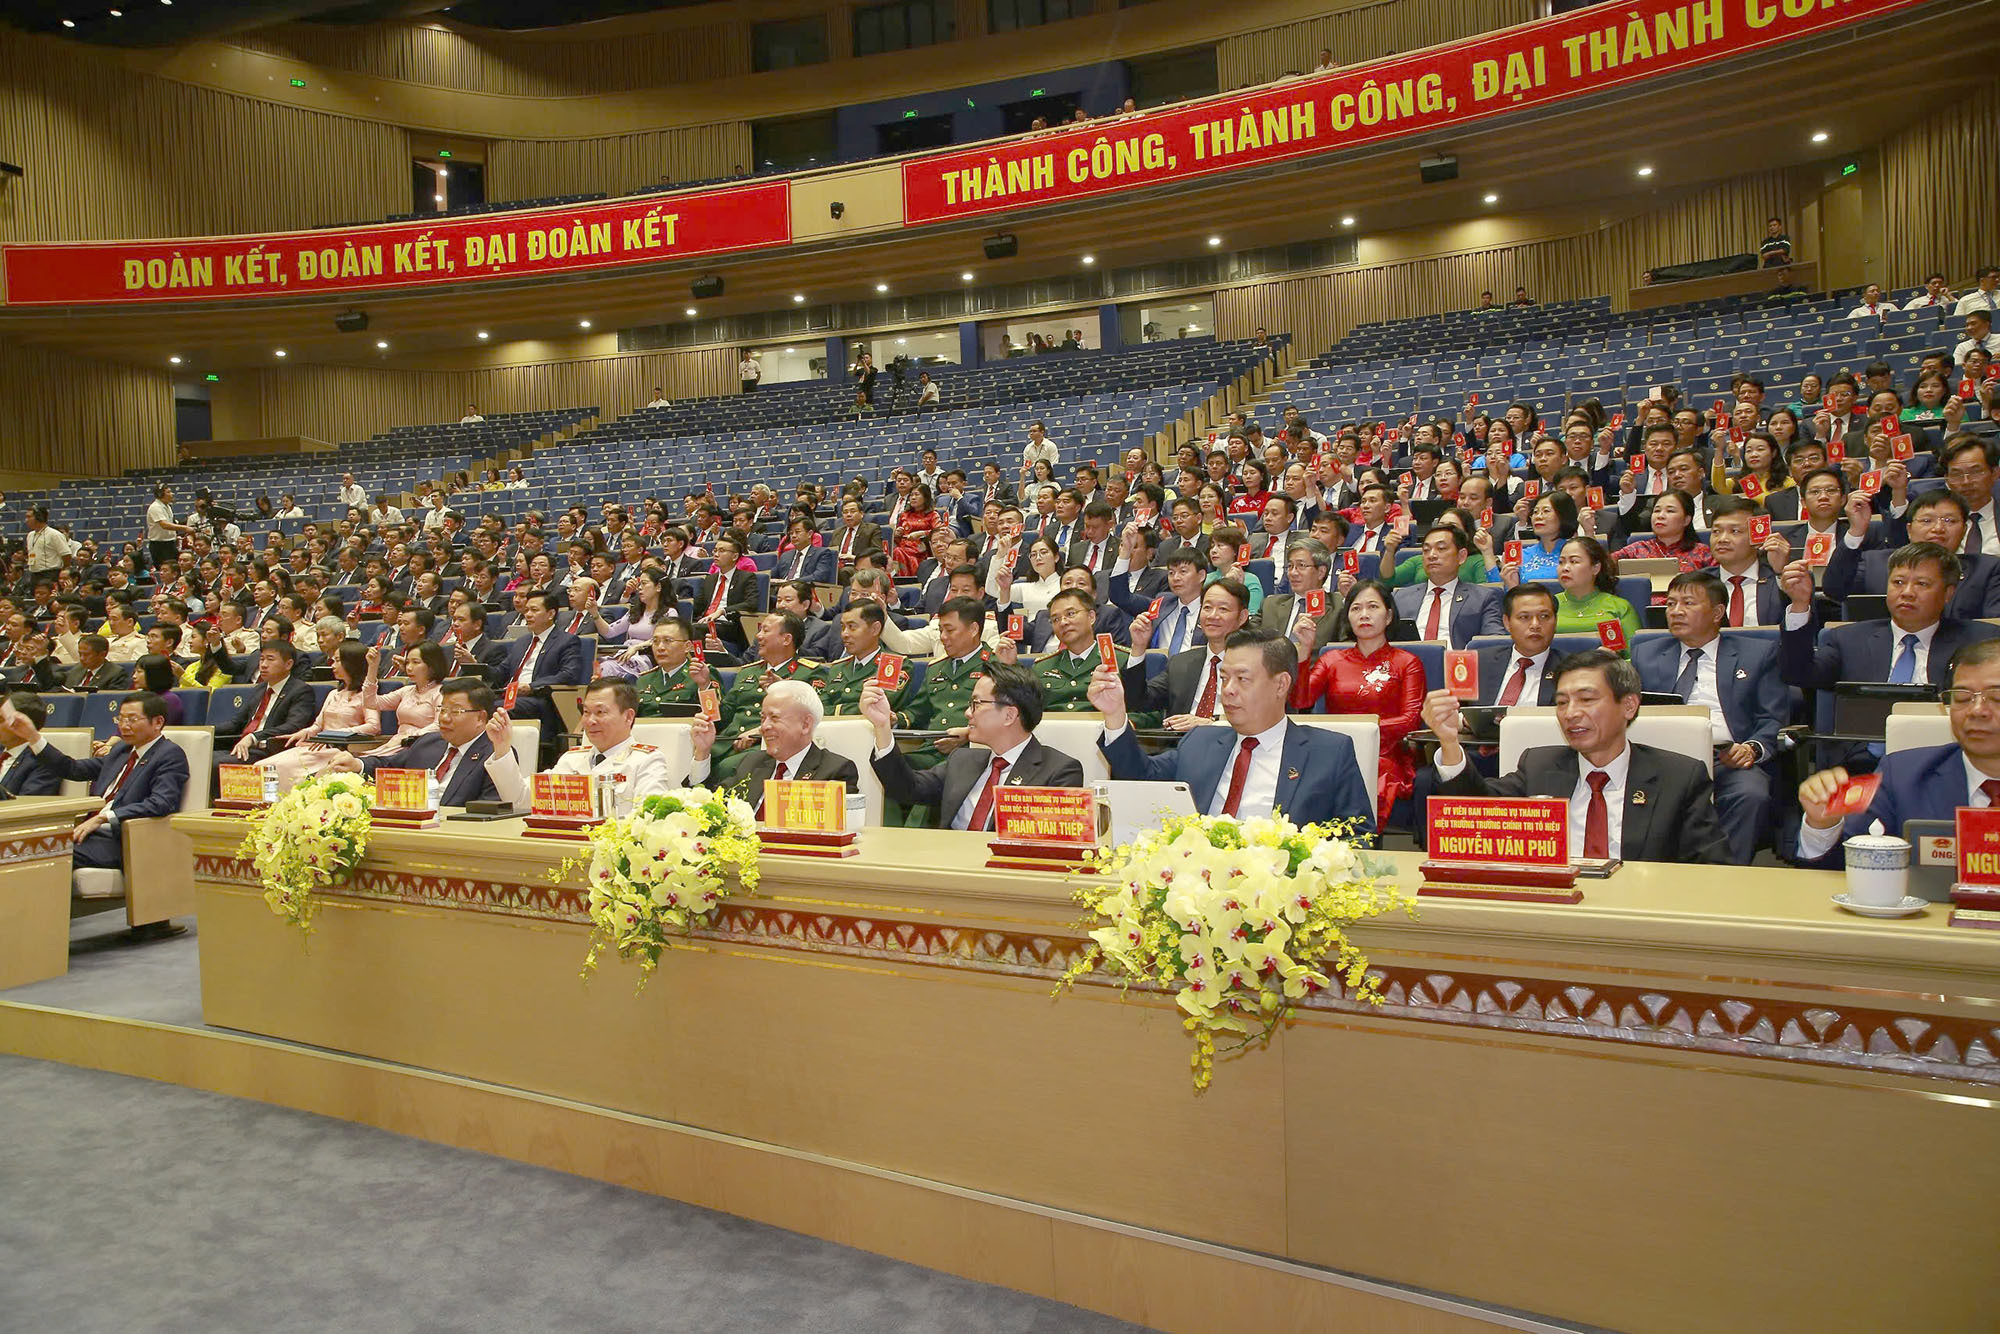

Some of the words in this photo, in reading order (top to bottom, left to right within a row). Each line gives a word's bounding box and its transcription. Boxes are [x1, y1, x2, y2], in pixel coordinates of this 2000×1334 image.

[942, 154, 1054, 205] THÀNH
[1067, 133, 1177, 183] CÔNG,
[1189, 101, 1316, 161] THÀNH
[1330, 73, 1457, 132] CÔNG,
[1472, 46, 1546, 102] ĐẠI
[1562, 2, 1724, 78] THÀNH
[123, 252, 213, 289] ĐOÀN
[225, 244, 287, 286] KẾT,
[298, 241, 383, 281] ĐOÀN
[394, 231, 455, 273] KẾT,
[465, 233, 517, 271] ĐẠI
[527, 219, 611, 261] ĐOÀN
[623, 205, 679, 250] KẾT
[1443, 803, 1451, 815] ỦY
[1453, 805, 1466, 816] VIÊN
[1468, 807, 1482, 816] BAN
[1483, 805, 1507, 817] THƯỜNG
[1509, 808, 1518, 818] VỤ
[1519, 806, 1540, 817] THÀNH
[1542, 806, 1551, 818] ỦY
[1007, 819, 1036, 836] PHẠM
[1037, 818, 1057, 835] VĂN
[1059, 820, 1084, 836] THÉP
[1502, 819, 1522, 831] CHÍNH
[1523, 821, 1533, 832] TRỊ
[1535, 820, 1543, 831] TÔ
[1439, 832, 1492, 855] NGUYỄN
[1496, 835, 1525, 856] VĂN
[1528, 836, 1557, 858] PHÚ
